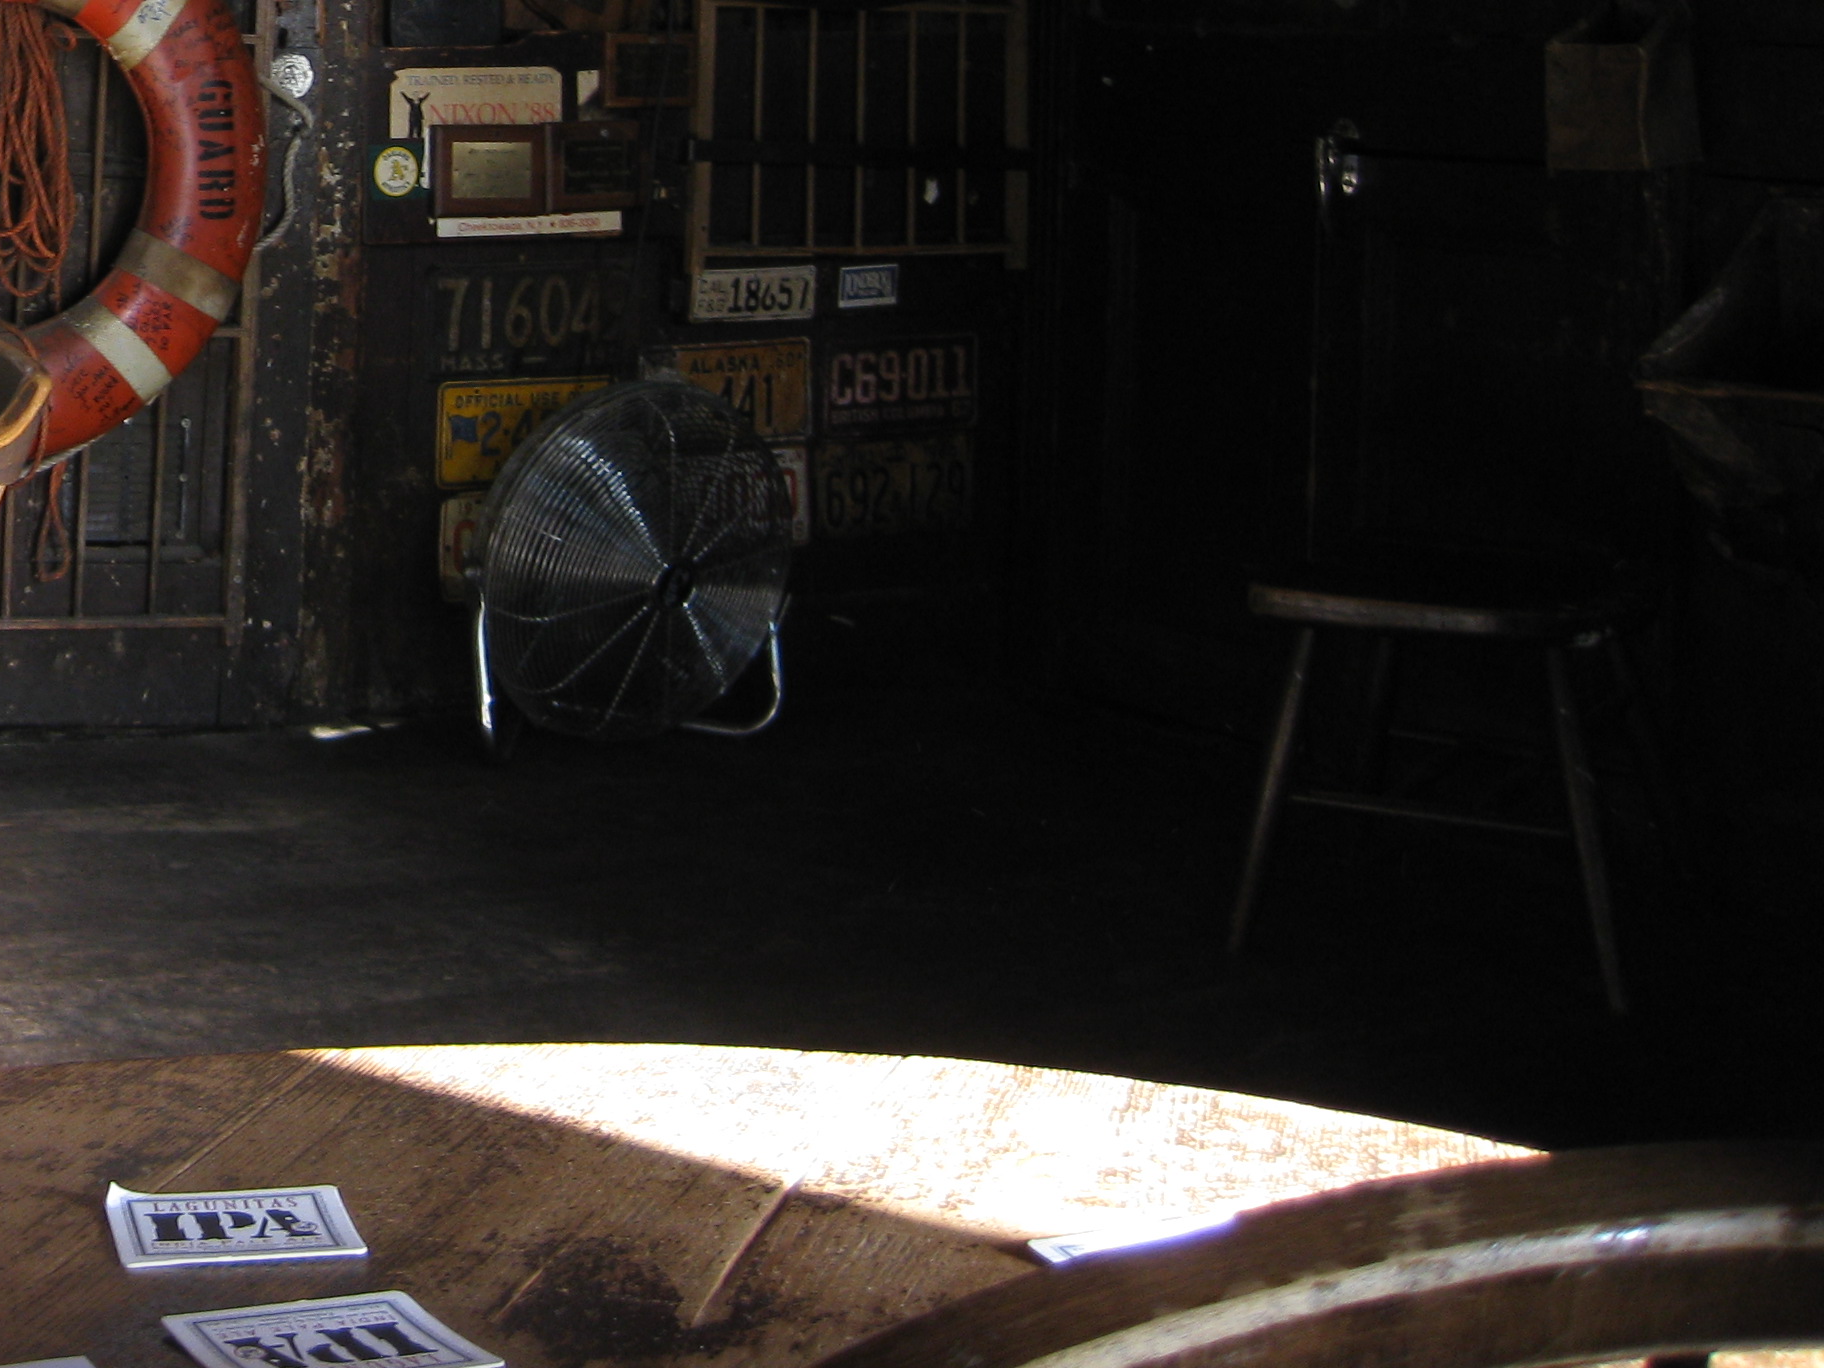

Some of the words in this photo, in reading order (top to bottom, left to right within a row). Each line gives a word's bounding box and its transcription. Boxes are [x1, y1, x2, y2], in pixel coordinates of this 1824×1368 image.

[429, 102, 518, 125] NIXON
[523, 100, 556, 124] '88
[197, 79, 236, 220] GUARD
[728, 276, 811, 313] 18657
[440, 355, 506, 373] MASS
[690, 354, 761, 375] ALASKA
[455, 391, 523, 409] OFFICIAL
[530, 390, 561, 406] USE
[153, 1196, 298, 1213] LAGUNITAS
[144, 1209, 323, 1243] IPA
[224, 1322, 439, 1368] IPA
